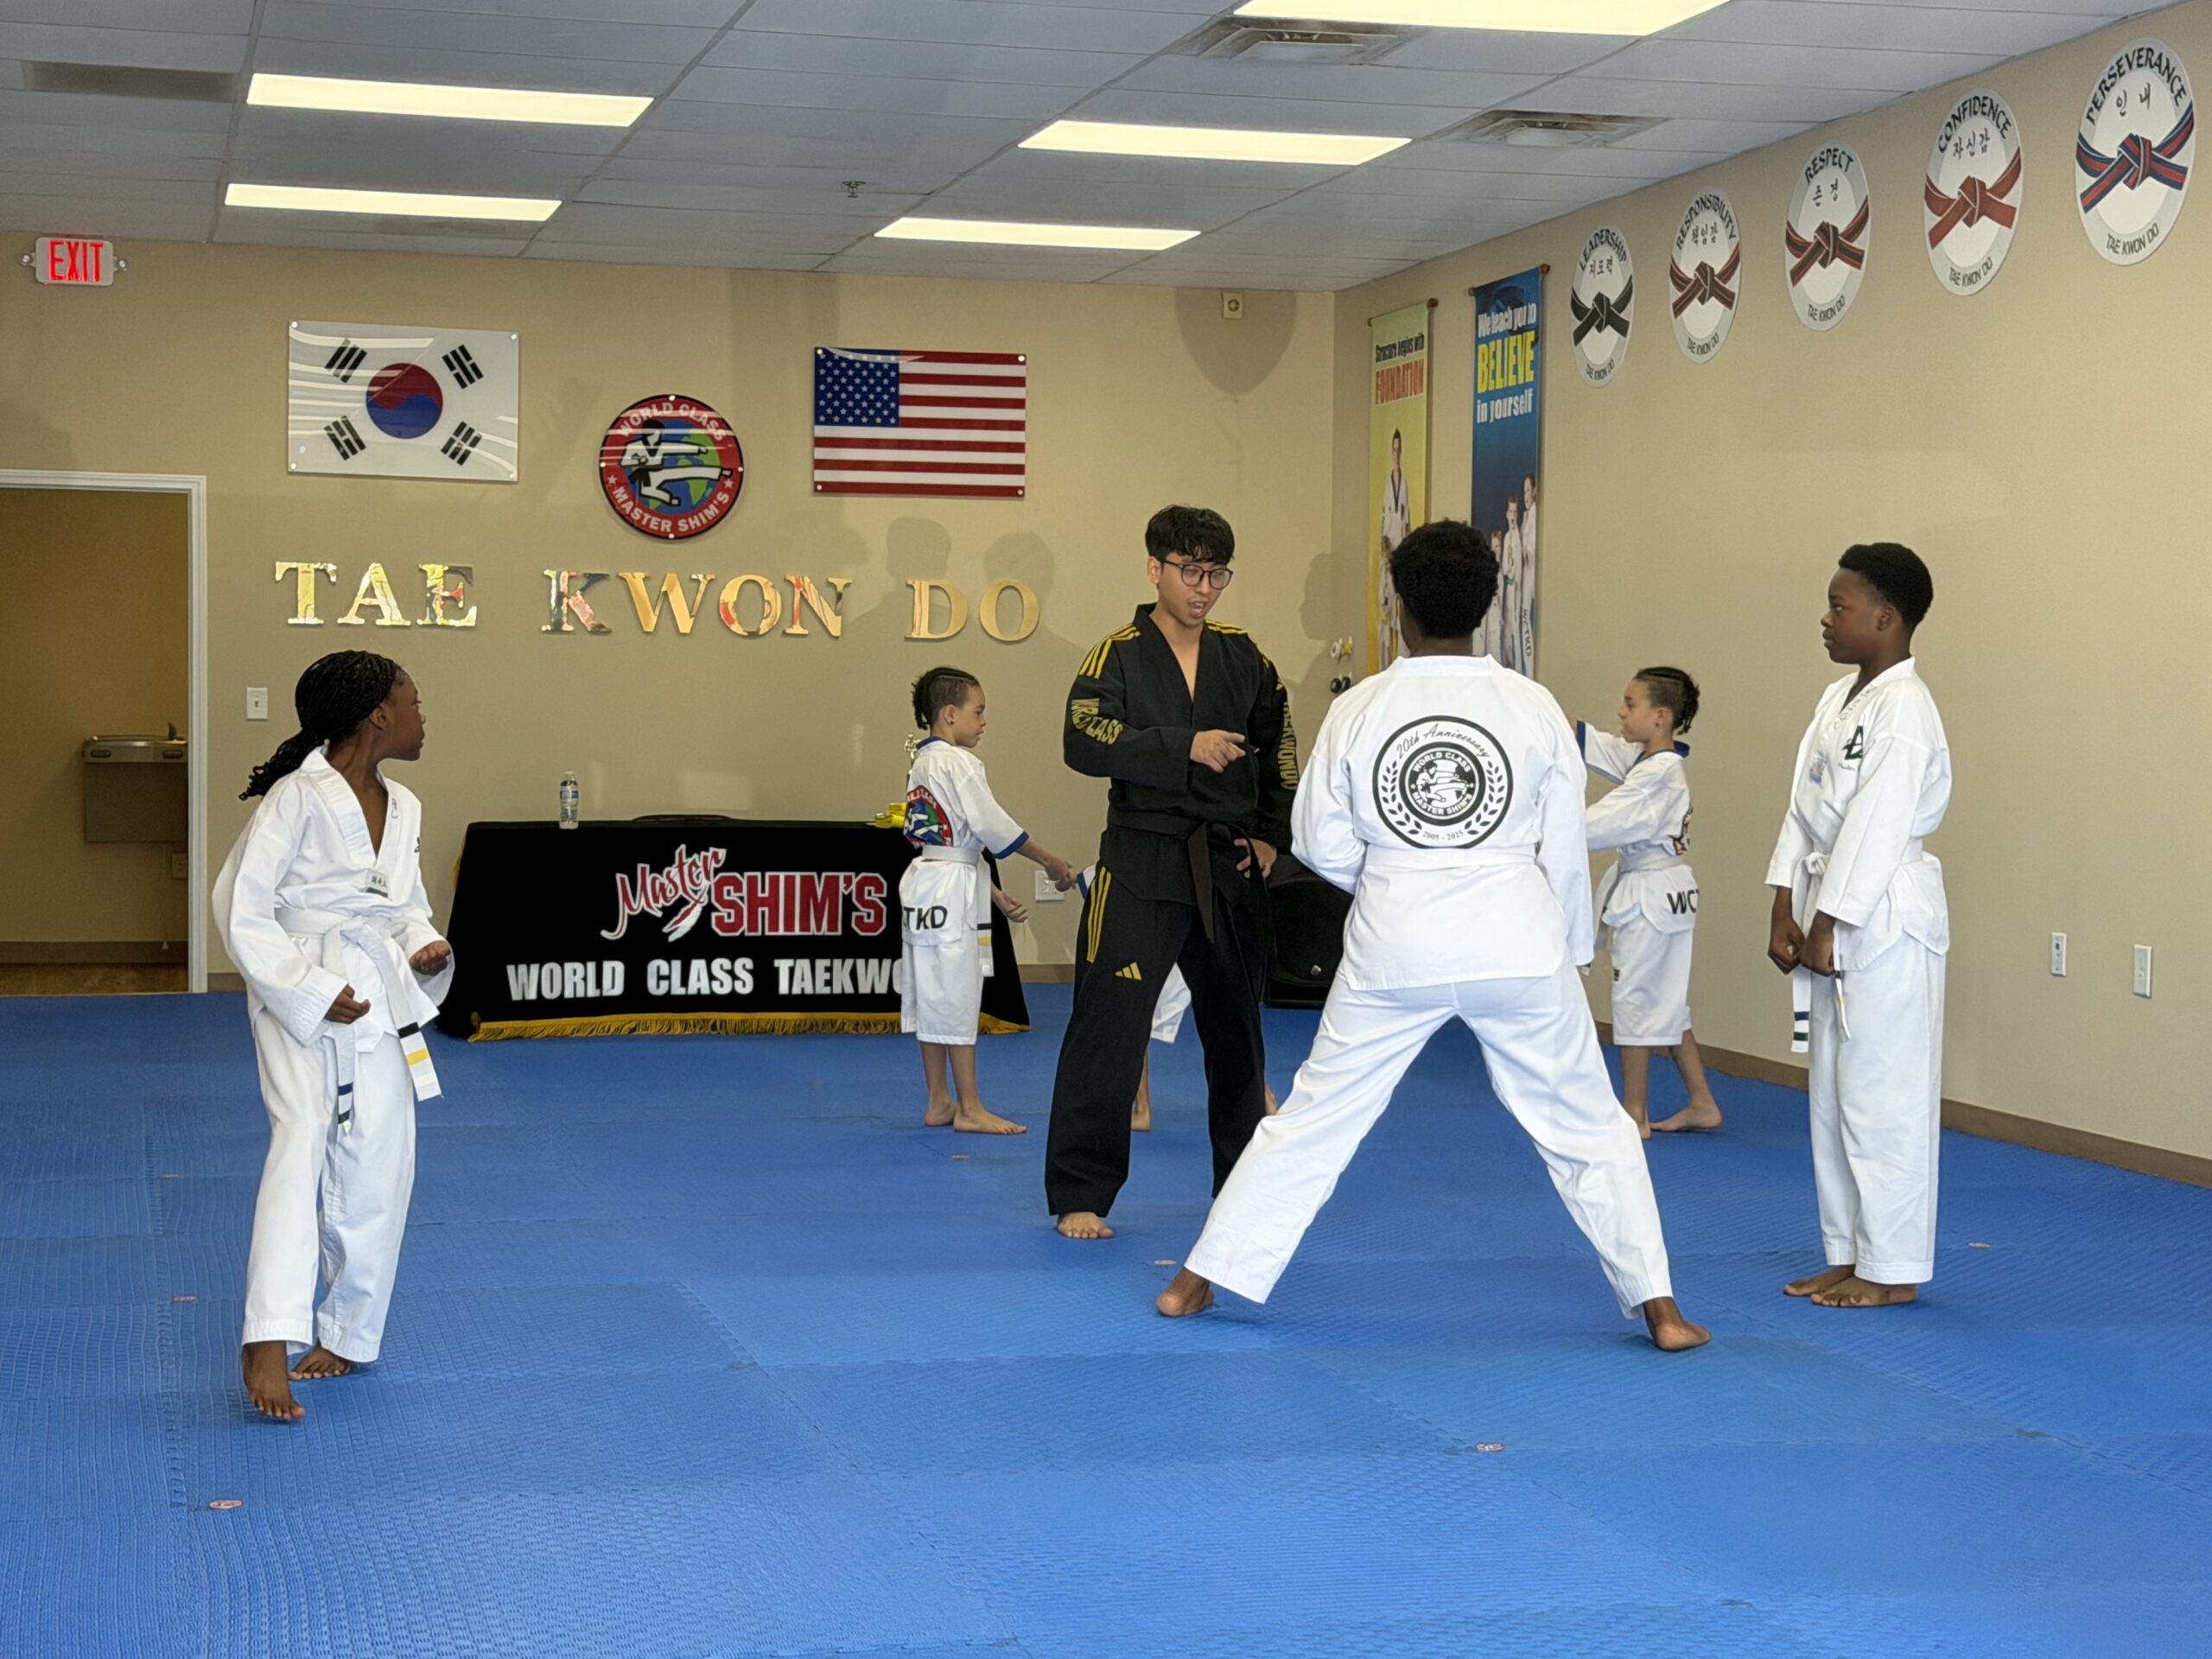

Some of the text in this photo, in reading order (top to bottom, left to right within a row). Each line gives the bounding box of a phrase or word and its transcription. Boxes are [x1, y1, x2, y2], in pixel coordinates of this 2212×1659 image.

[2086, 47, 2187, 125] PERSEVERANCE
[1938, 95, 2012, 153] CONFIDENCE
[1804, 147, 1854, 185] RESPECT
[1675, 193, 1737, 251] RESPONSIBILITY
[2106, 222, 2159, 256] TAE KWON DO
[48, 239, 105, 283] EXIT
[1580, 228, 1627, 272] LEADERSHIP
[1948, 257, 1993, 287] TAE KWON DO
[1478, 313, 1491, 339] We
[1491, 305, 1512, 334] teach
[1513, 305, 1527, 332] you
[1477, 330, 1535, 394] BELIEVE
[618, 402, 727, 442] WORLD CLASS
[1477, 387, 1534, 423] in yourself
[613, 486, 730, 532] MASTER SHIM'S
[275, 561, 1039, 643] TAE KWON DO
[1396, 730, 1420, 760] 20th
[1413, 752, 1471, 772] WORLD CLASS
[1412, 791, 1445, 816] MASTER
[600, 843, 887, 941] Master SHIM'S
[1666, 888, 1700, 915] WC
[506, 960, 625, 1001] WORLD
[646, 956, 753, 996] CLASS
